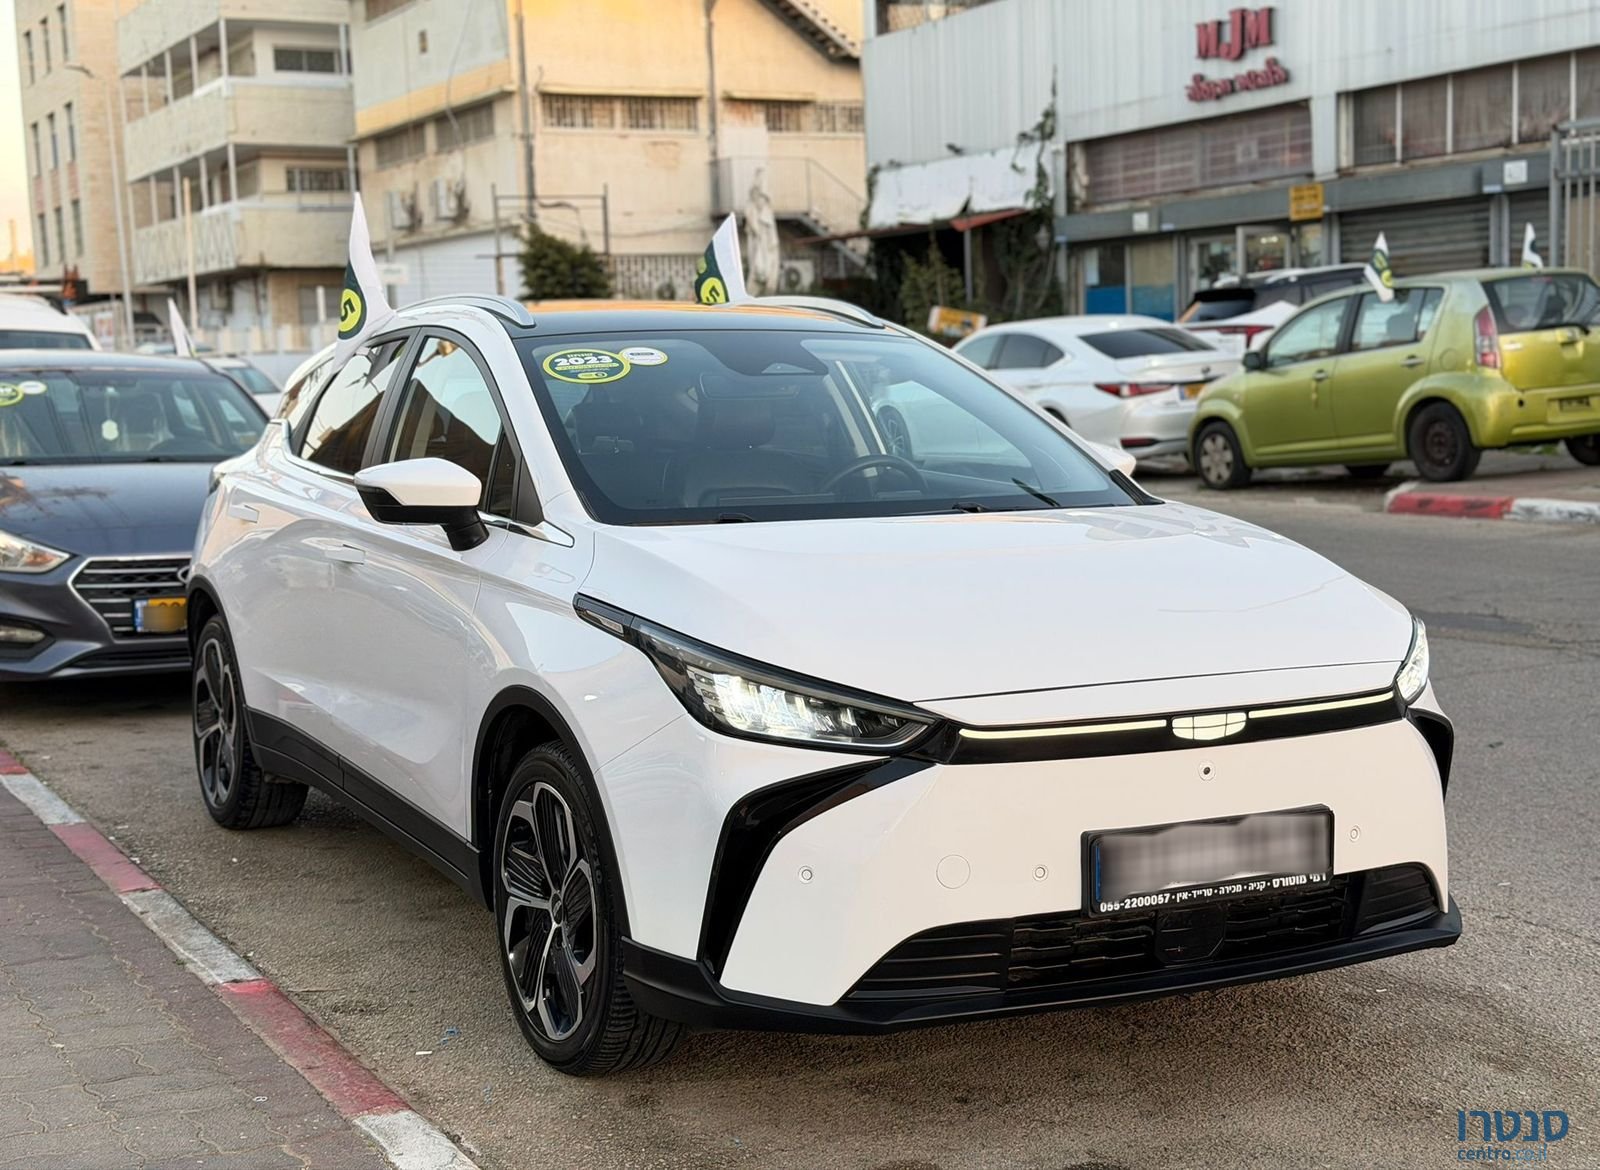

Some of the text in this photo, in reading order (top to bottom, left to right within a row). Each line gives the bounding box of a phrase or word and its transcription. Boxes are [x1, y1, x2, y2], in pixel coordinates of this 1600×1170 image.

[1196, 7, 1272, 61] MJM
[554, 355, 614, 366] 2023
[1248, 880, 1267, 892] קניה
[1271, 874, 1307, 889] מוטורס
[1176, 888, 1213, 903] טרייד-אין
[1218, 884, 1243, 896] מכירה
[1100, 893, 1170, 913] 055-2200057
